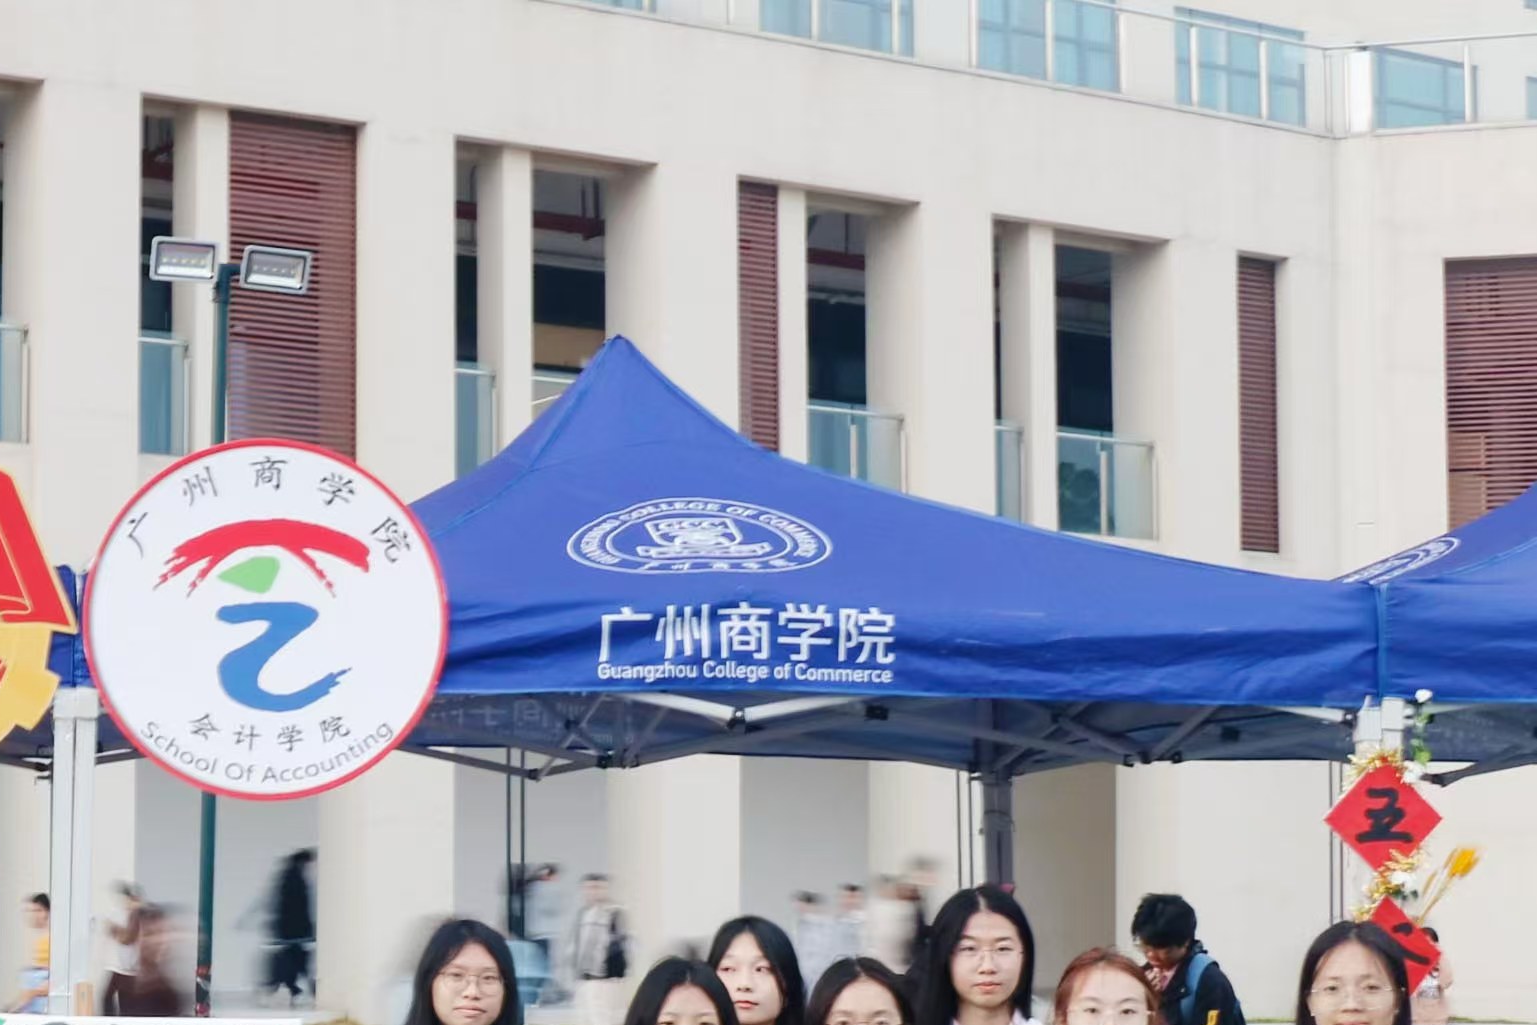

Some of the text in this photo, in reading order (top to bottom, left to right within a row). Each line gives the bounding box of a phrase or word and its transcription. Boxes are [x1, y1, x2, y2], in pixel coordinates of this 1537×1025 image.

[126, 455, 412, 564] 广州商学院
[598, 602, 895, 664] 广州商学院
[598, 660, 893, 683] Guangzhou College of Commerce
[140, 720, 218, 776] School
[225, 761, 256, 784] Of
[261, 720, 395, 784] Accounting
[188, 712, 351, 752] 会计学院
[1356, 787, 1414, 843] 五
